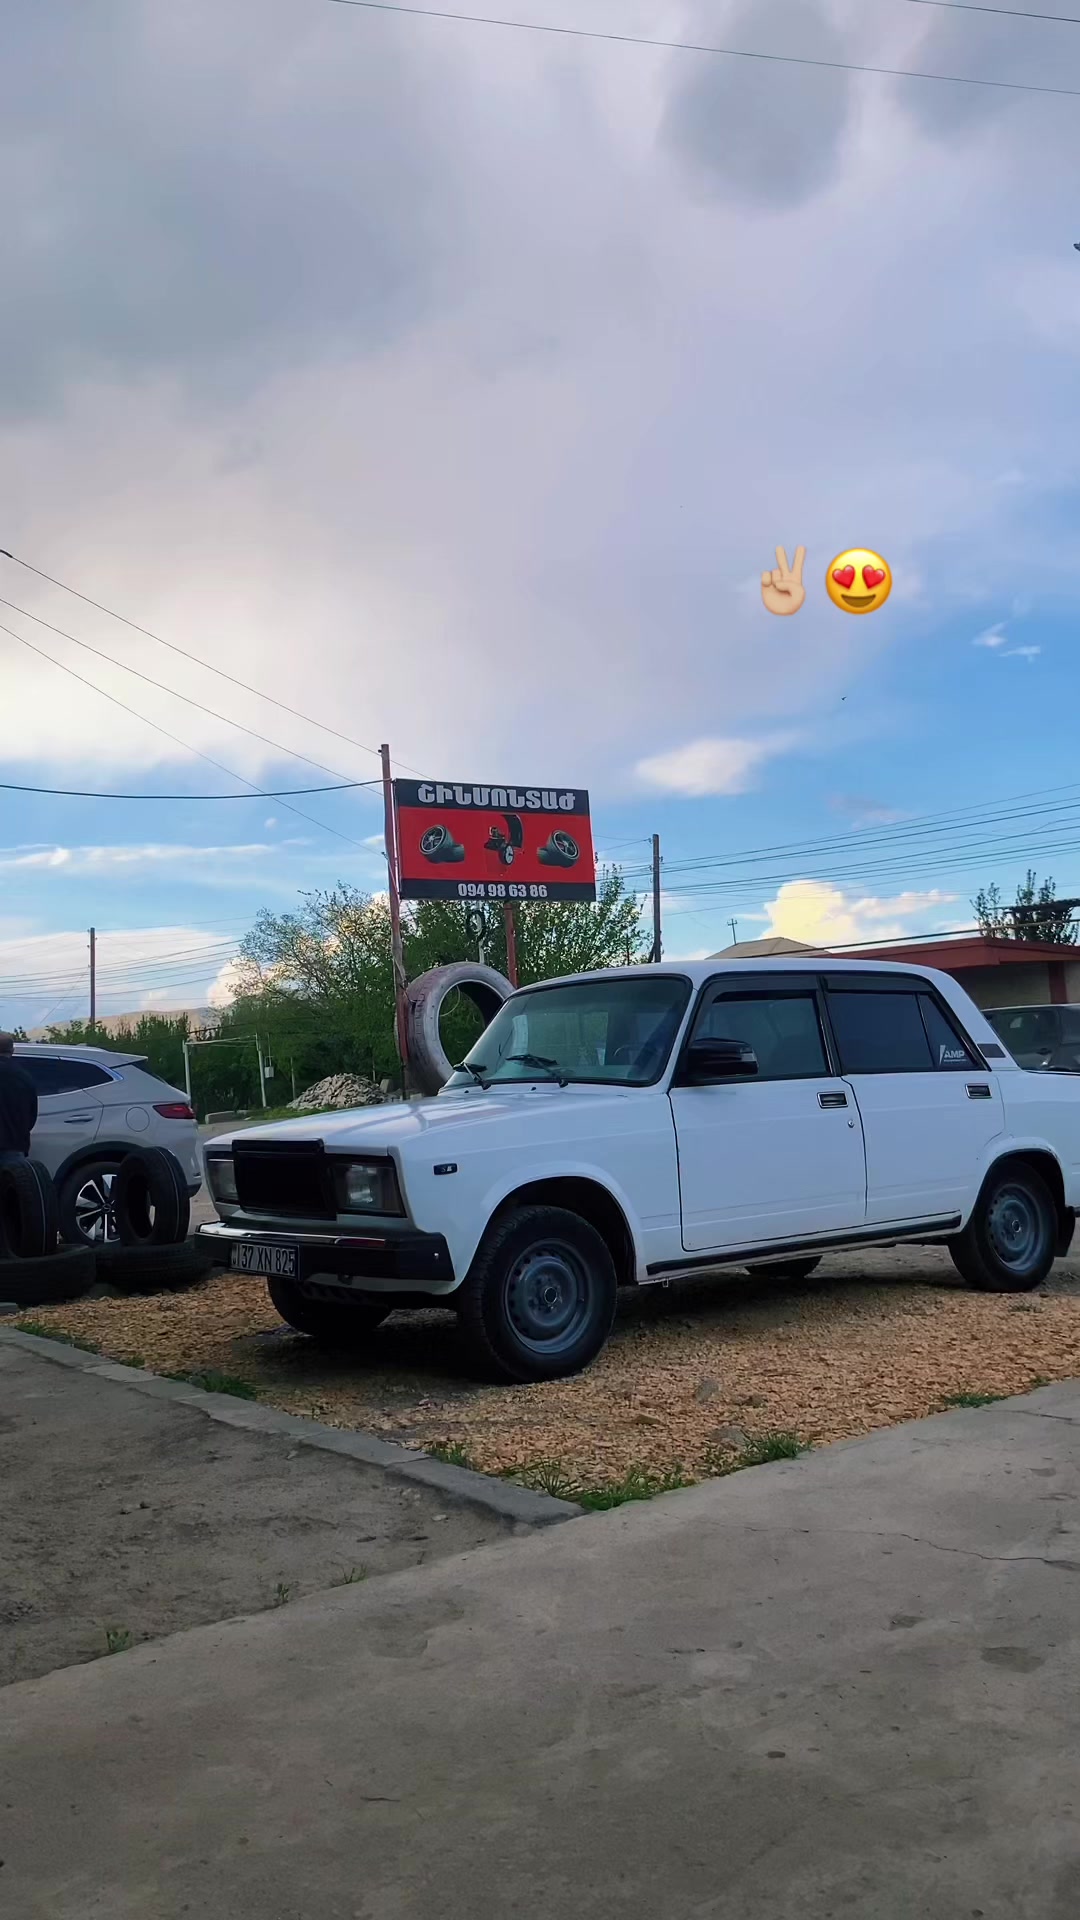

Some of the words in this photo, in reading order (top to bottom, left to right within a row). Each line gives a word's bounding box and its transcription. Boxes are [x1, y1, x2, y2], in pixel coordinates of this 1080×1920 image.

[417, 783, 576, 811] ՇԻՆՄՈՆՏԱԺ
[457, 883, 485, 897] 094
[487, 884, 506, 897] 98
[508, 884, 527, 897] 63
[529, 884, 548, 898] 86
[944, 1050, 965, 1058] AMP
[241, 1245, 254, 1269] 37
[257, 1247, 272, 1272] XN
[275, 1248, 295, 1274] 825
